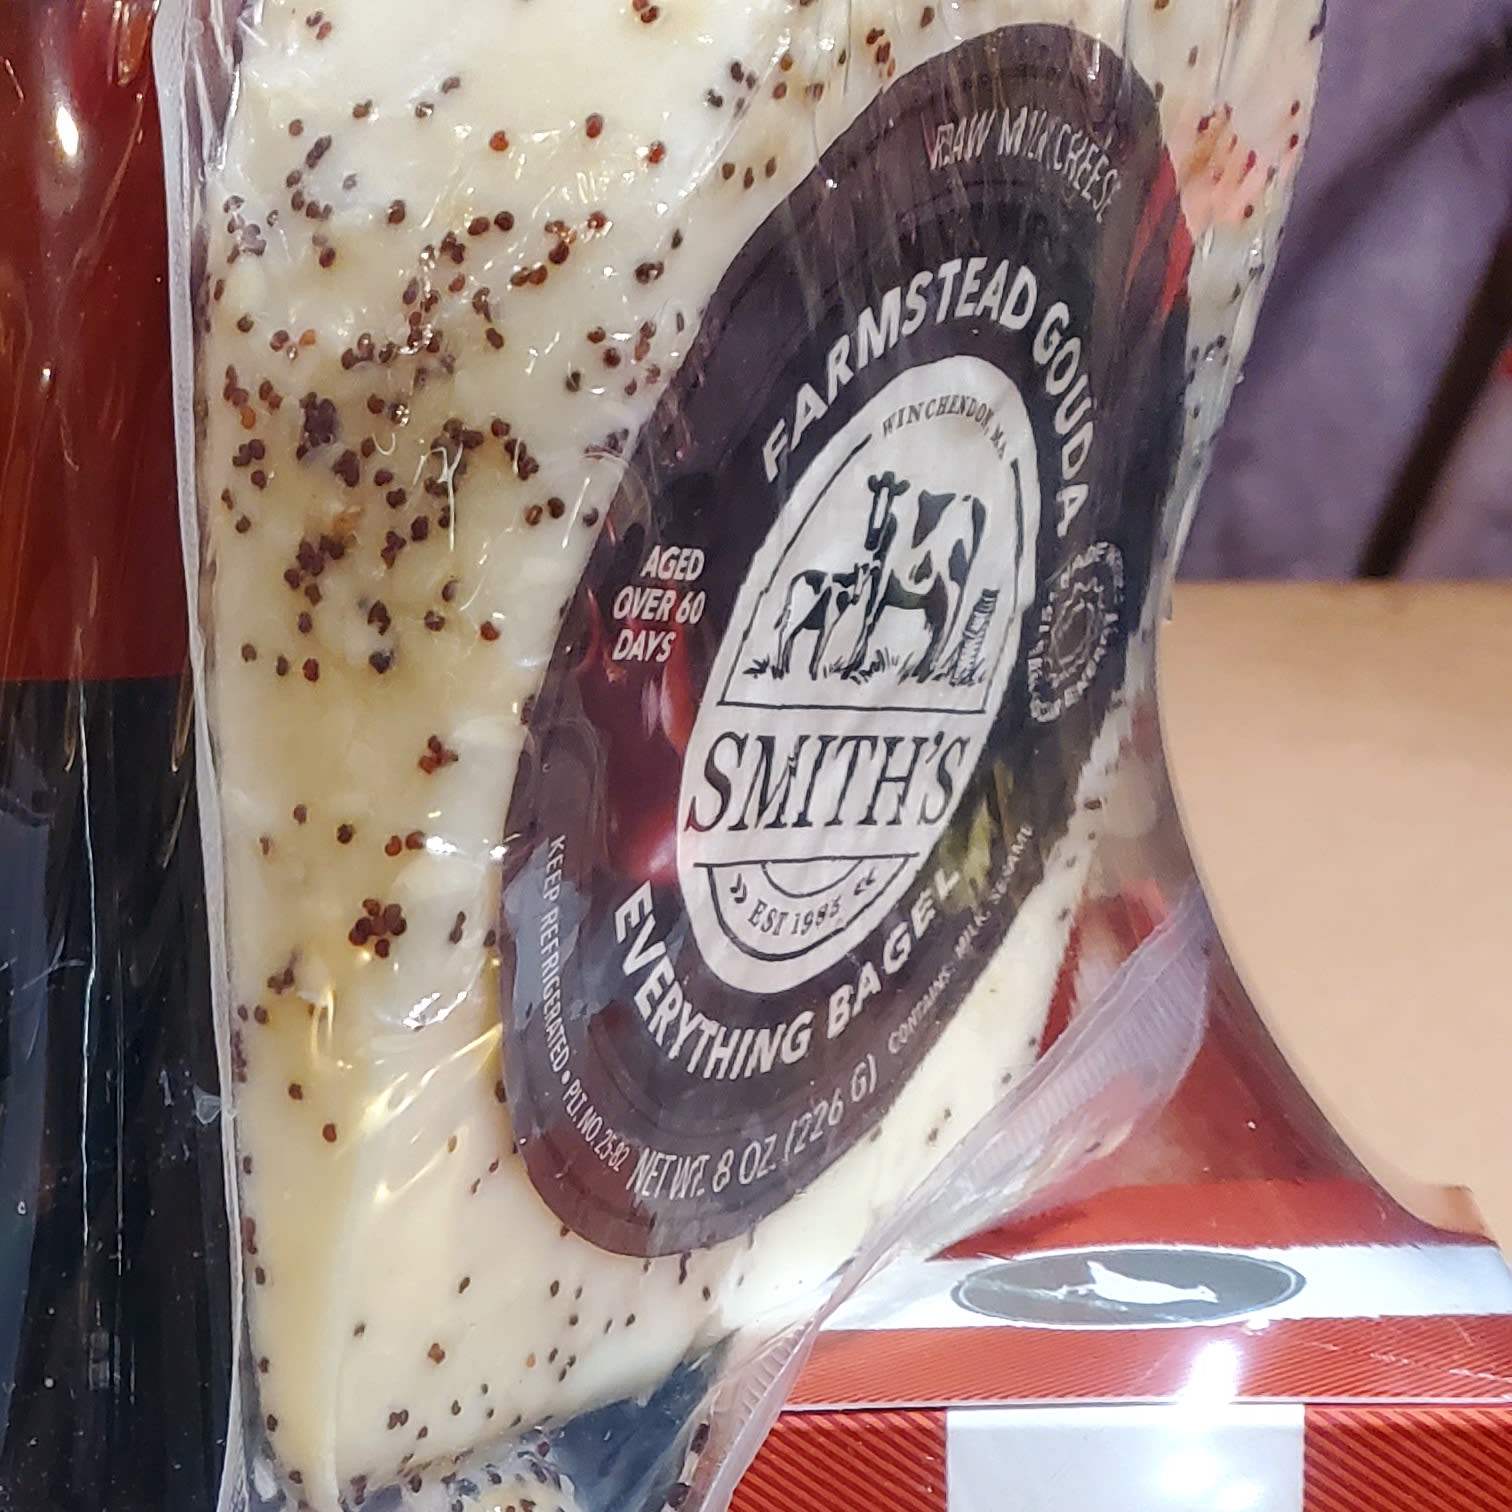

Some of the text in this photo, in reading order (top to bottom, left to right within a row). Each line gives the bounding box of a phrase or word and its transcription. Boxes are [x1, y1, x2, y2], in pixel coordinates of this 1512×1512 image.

[762, 256, 1096, 538] FARMSTEAD GOUDA
[613, 586, 706, 624] OVER 60
[639, 545, 705, 581] AGED
[611, 628, 677, 663] DAYS
[684, 730, 970, 832] SMITH'S
[542, 834, 566, 902] KEEP
[747, 899, 789, 936] EST
[539, 905, 570, 1074] REFRIGERATED
[614, 867, 960, 1080] EVERYTHING BAGEL
[626, 1146, 677, 1201] NET
[711, 1148, 735, 1193] 8
[782, 1086, 844, 1163] (226
[850, 1053, 878, 1103] G)
